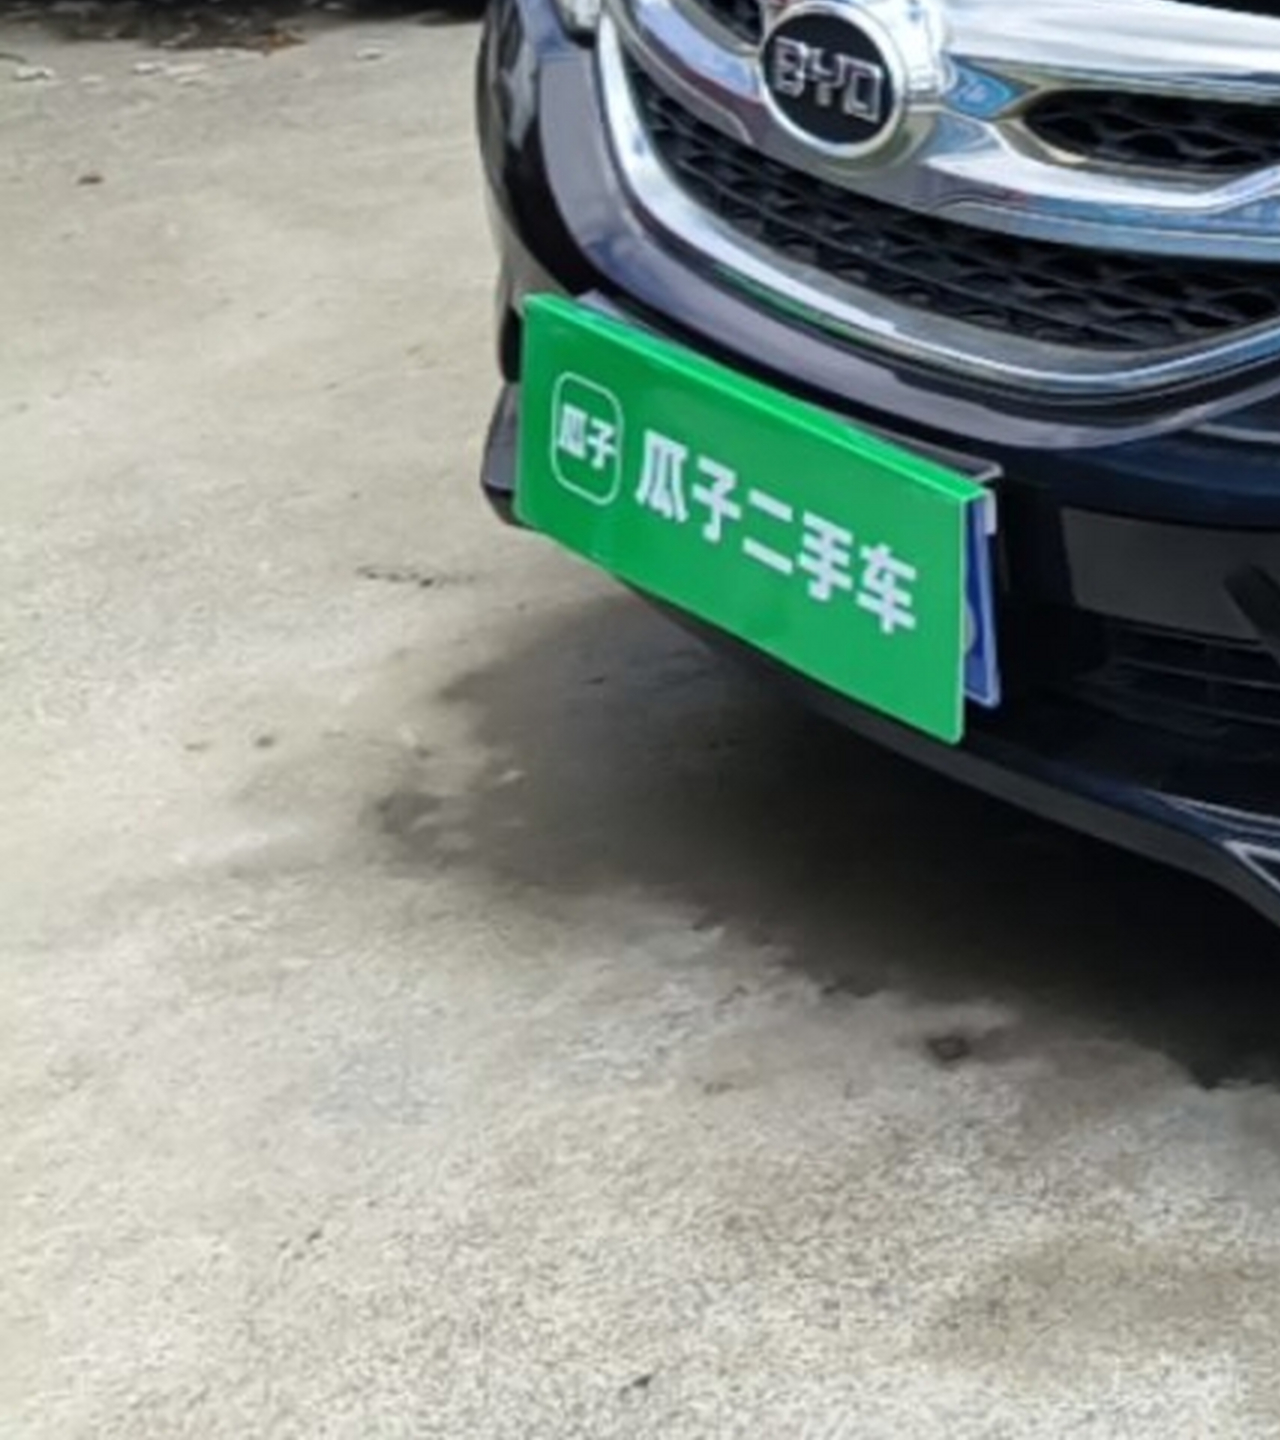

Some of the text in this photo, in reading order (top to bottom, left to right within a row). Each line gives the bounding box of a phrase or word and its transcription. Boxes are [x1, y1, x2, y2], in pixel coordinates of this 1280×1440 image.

[774, 35, 882, 123] BYD
[636, 428, 916, 634] 瓜子二手车
